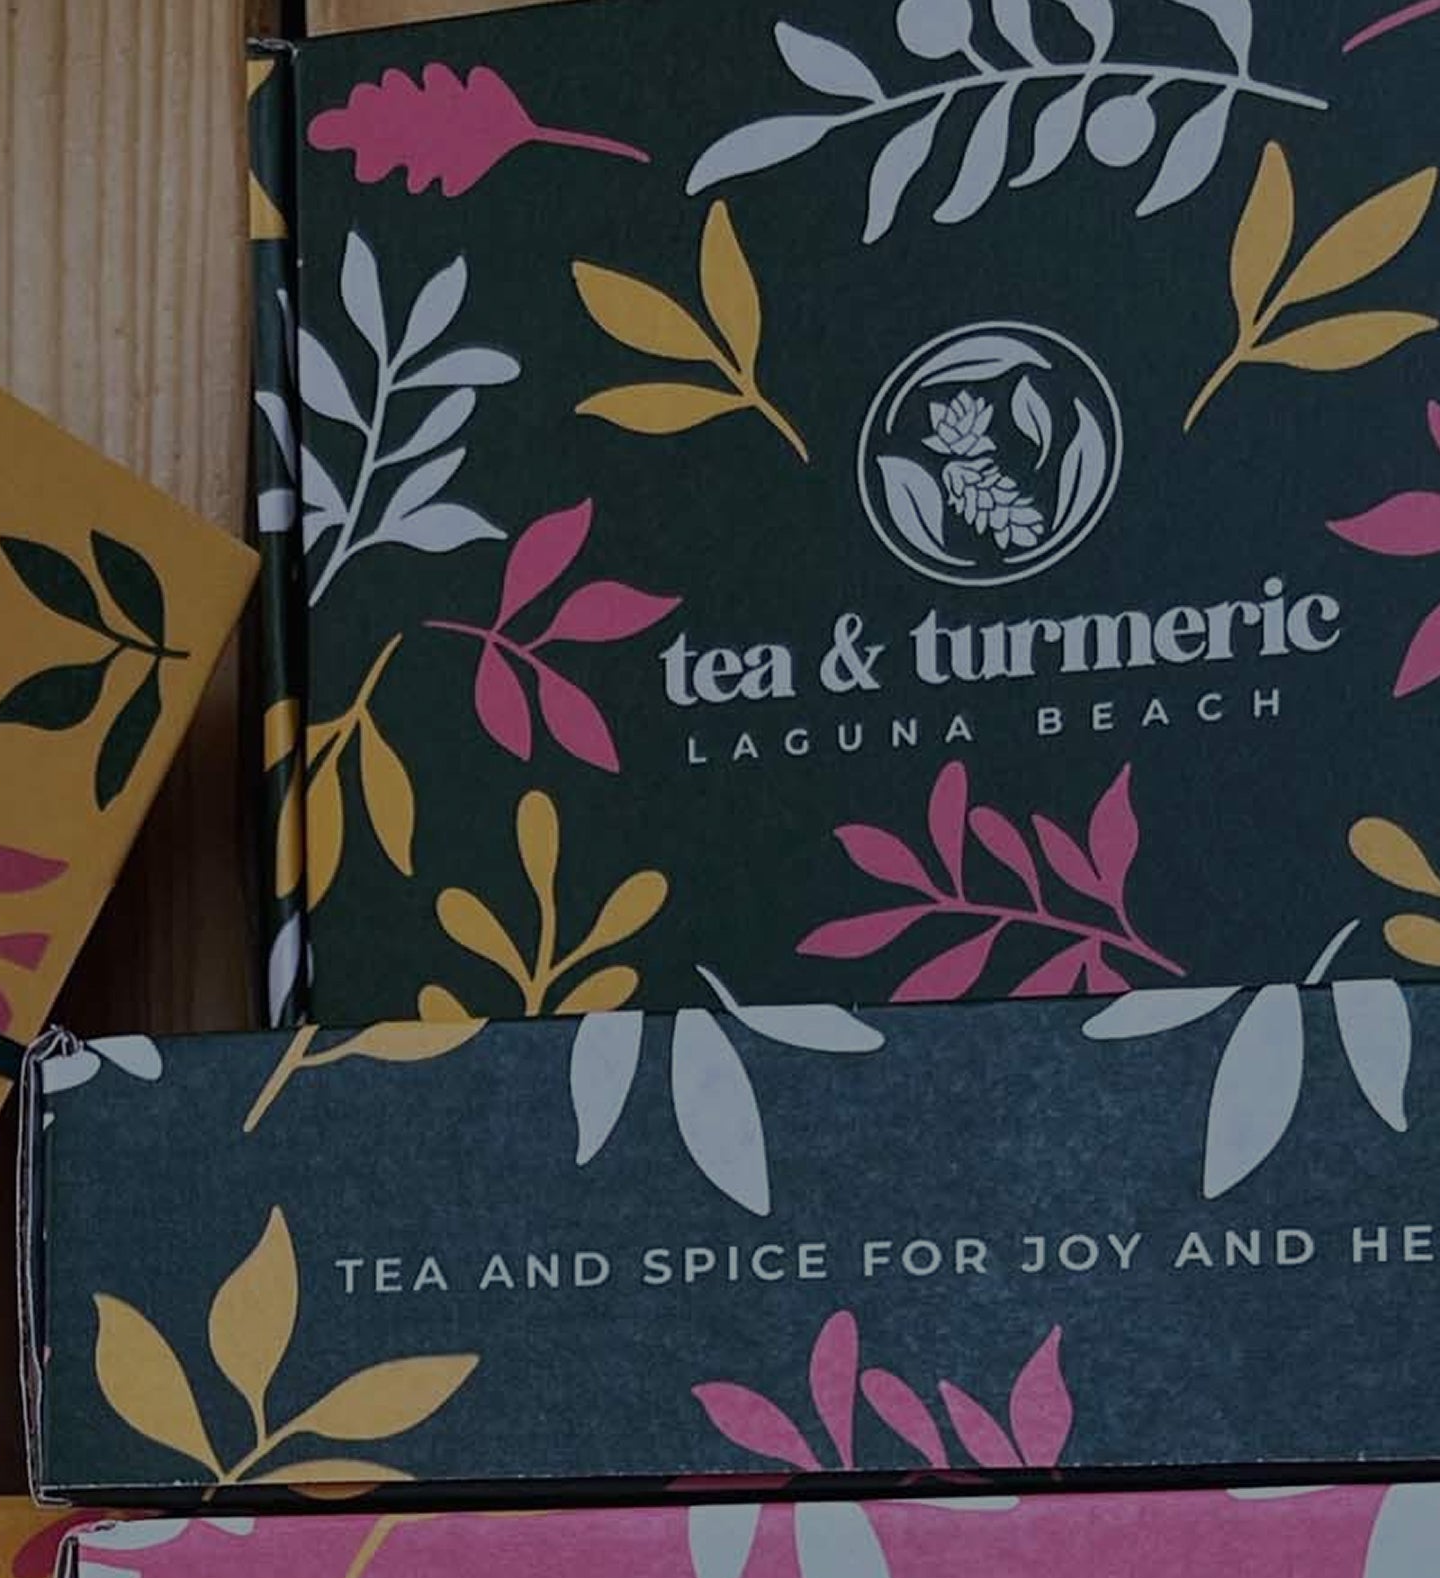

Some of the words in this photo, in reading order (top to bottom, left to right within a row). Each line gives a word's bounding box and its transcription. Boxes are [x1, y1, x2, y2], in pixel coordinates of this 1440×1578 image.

[658, 632, 797, 707] tea
[819, 612, 886, 693] &
[908, 576, 1341, 685] turmeric
[686, 706, 975, 765] LAGUNA
[1037, 688, 1281, 736] BEACH
[334, 1256, 449, 1294] TEA
[478, 1251, 611, 1291] AND
[642, 1242, 828, 1285] SPICE
[863, 1237, 988, 1278] FOR
[1020, 1232, 1142, 1273] JOY
[1173, 1228, 1315, 1269] AND
